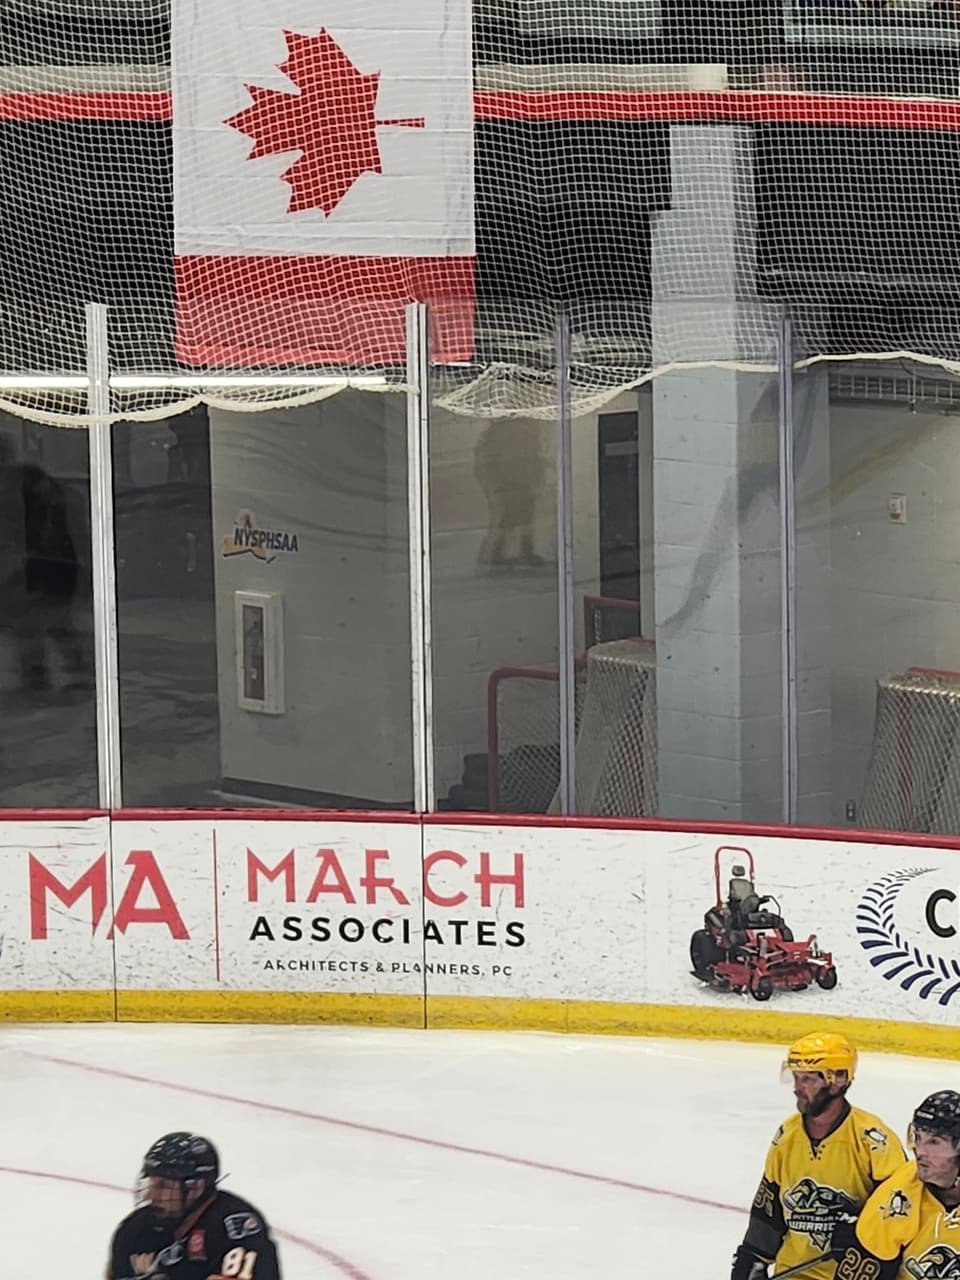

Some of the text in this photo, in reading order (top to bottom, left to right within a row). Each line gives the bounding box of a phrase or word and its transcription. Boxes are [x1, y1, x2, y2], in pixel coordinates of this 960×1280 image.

[234, 528, 298, 552] NYSPHSAA
[246, 847, 525, 908] MARCH
[28, 849, 191, 941] MA
[249, 915, 526, 947] ASSOCIATES
[263, 959, 513, 977] ARCHITECTS & PLANNERS, PC
[221, 1246, 257, 1280] 81
